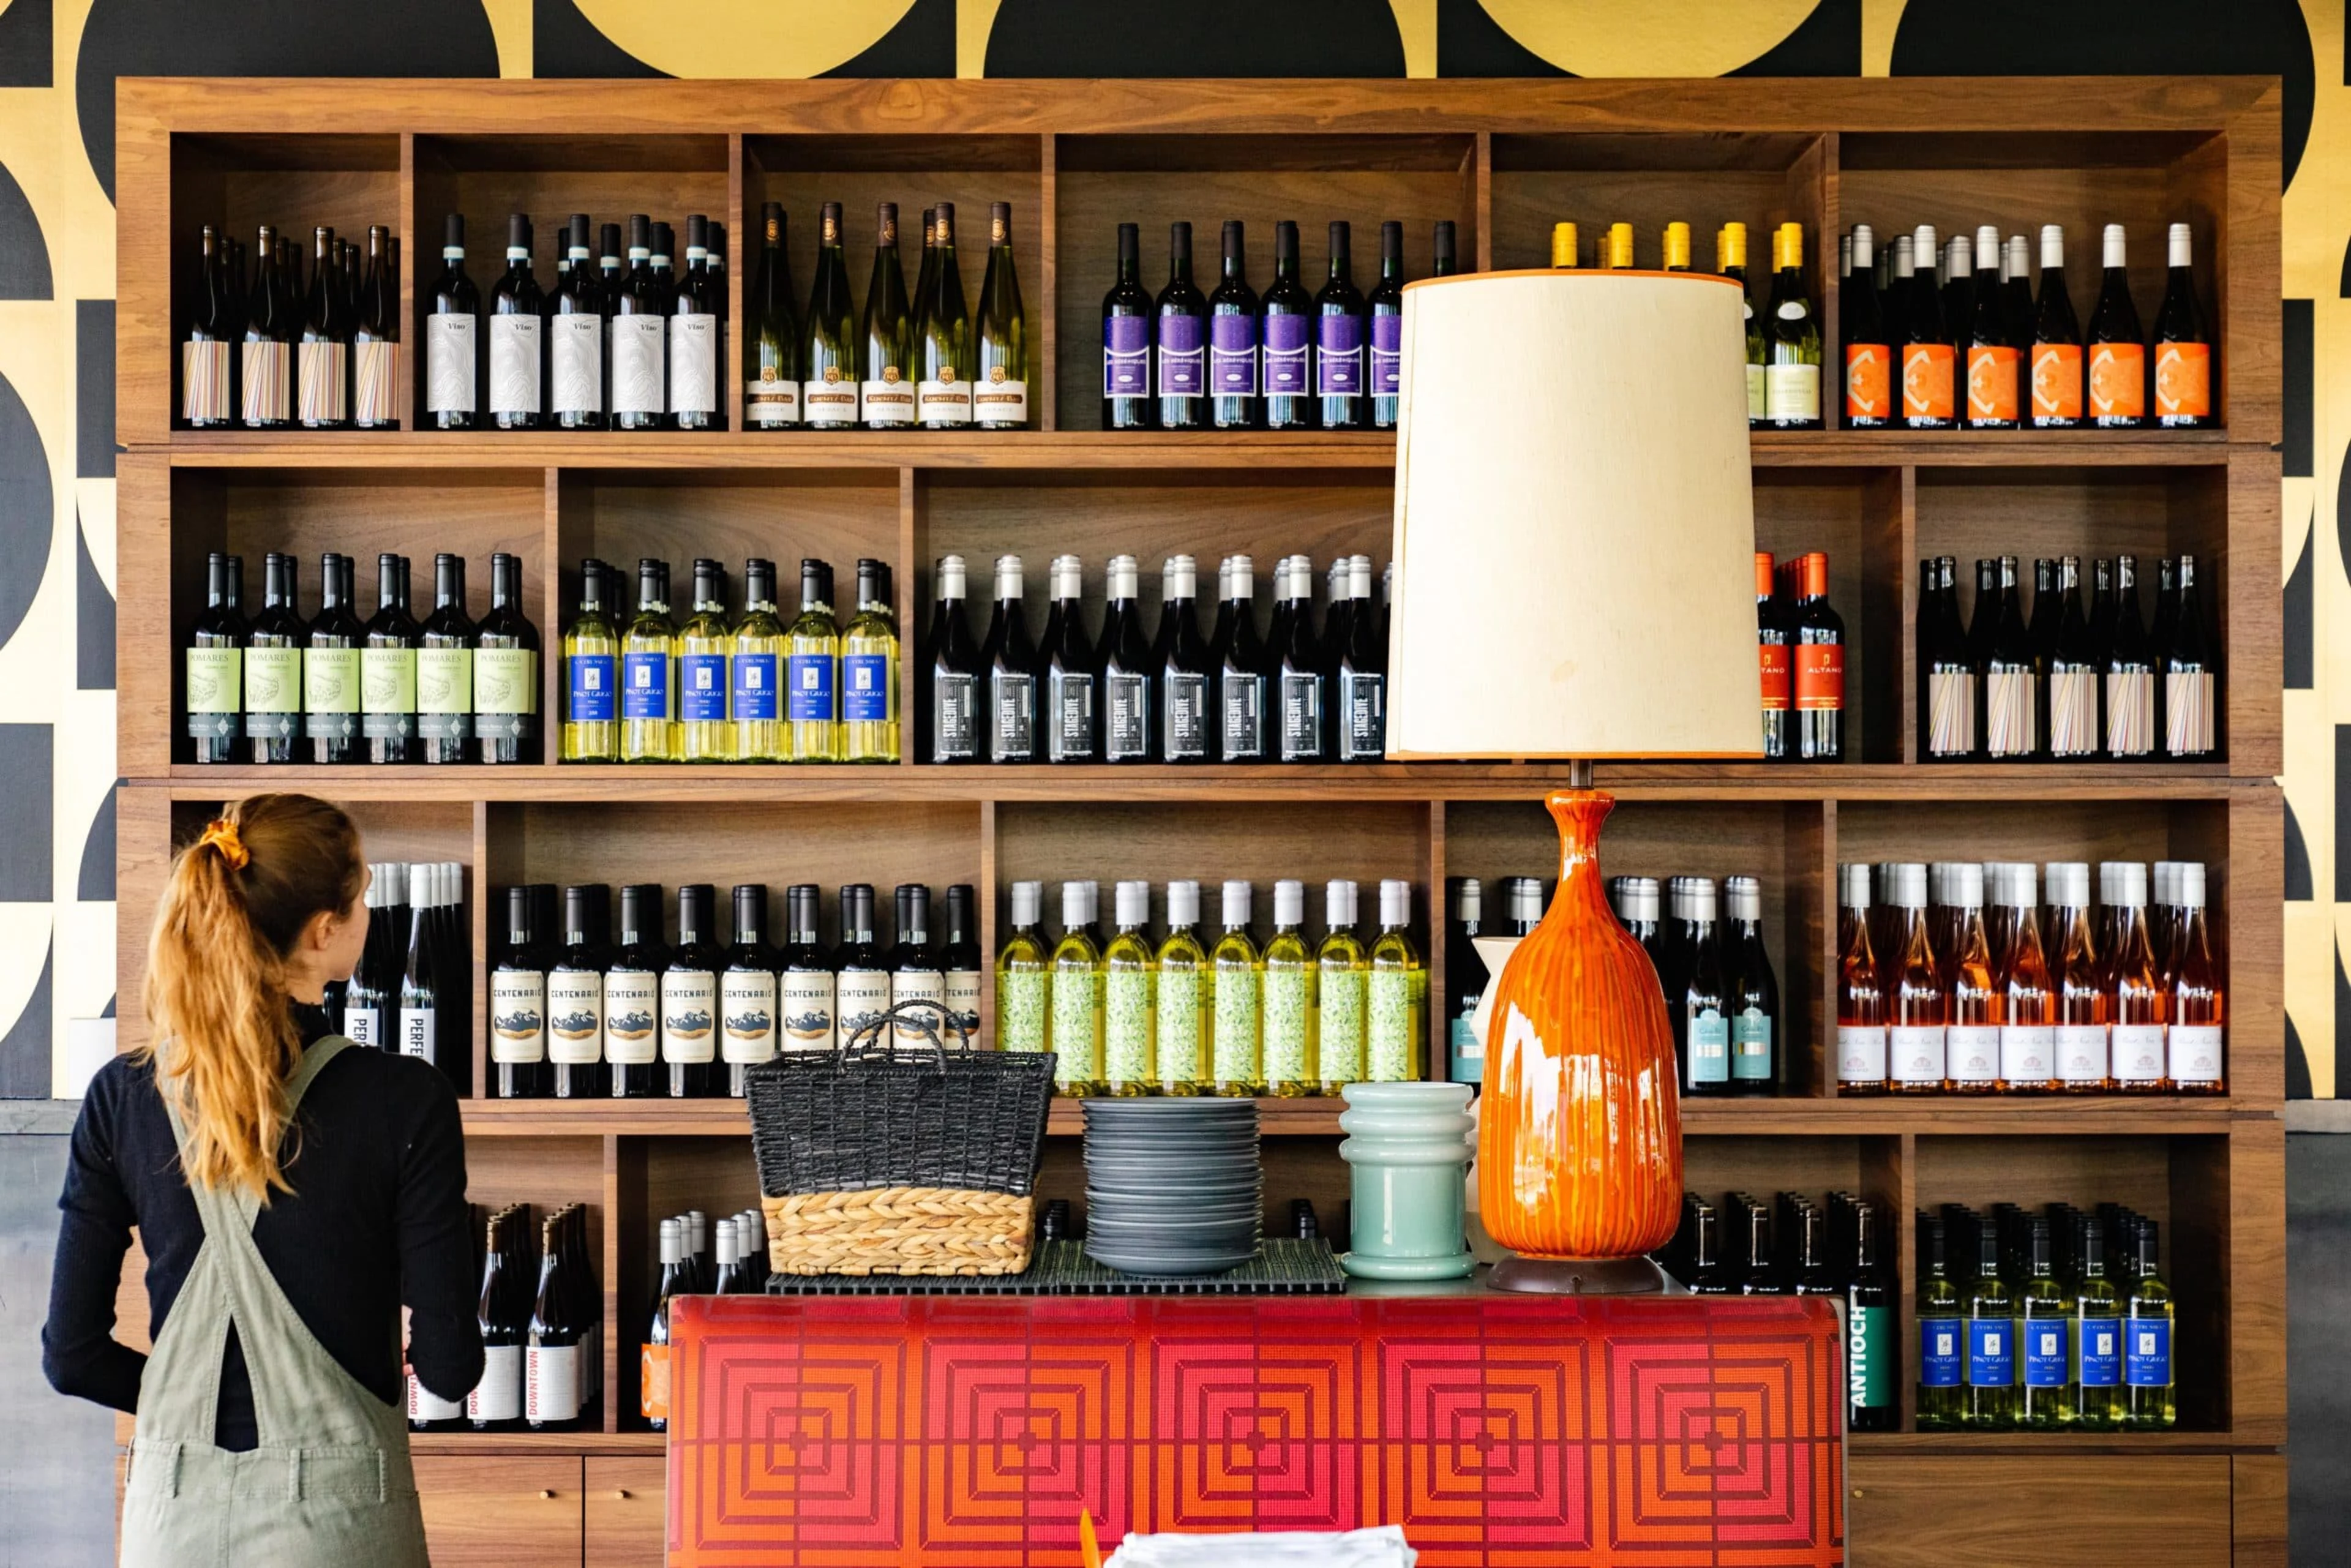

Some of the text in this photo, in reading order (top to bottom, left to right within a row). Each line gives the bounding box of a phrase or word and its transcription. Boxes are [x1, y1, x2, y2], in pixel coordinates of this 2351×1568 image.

[367, 654, 407, 662] POMARES
[421, 654, 462, 662] POMARES
[481, 654, 521, 662] POMARES
[943, 698, 958, 738] STAGEDIVE
[1001, 698, 1016, 738] STAGEDIVE
[1064, 698, 1079, 738] STAGEDIVE
[1113, 698, 1128, 738] STAGEDIVE
[1175, 697, 1190, 737] STAGEDIVE
[1228, 697, 1242, 737] STAGEDIVE
[1287, 697, 1302, 737] STAGEDIVE
[1354, 697, 1368, 737] STAGEDIVE
[493, 989, 541, 997] CENTENARIO
[552, 989, 599, 998] CENTENARIO
[607, 990, 655, 999] CENTENARIO
[665, 989, 713, 998] CENTENARIO
[725, 989, 772, 999] CENTENARIO
[785, 989, 831, 998] CENTENARIO
[839, 989, 887, 998] CENTENARIO
[410, 1019, 424, 1057] PERFE
[1850, 1306, 1867, 1407] ANTIOCH
[528, 1351, 538, 1416] DOWNTOWN
